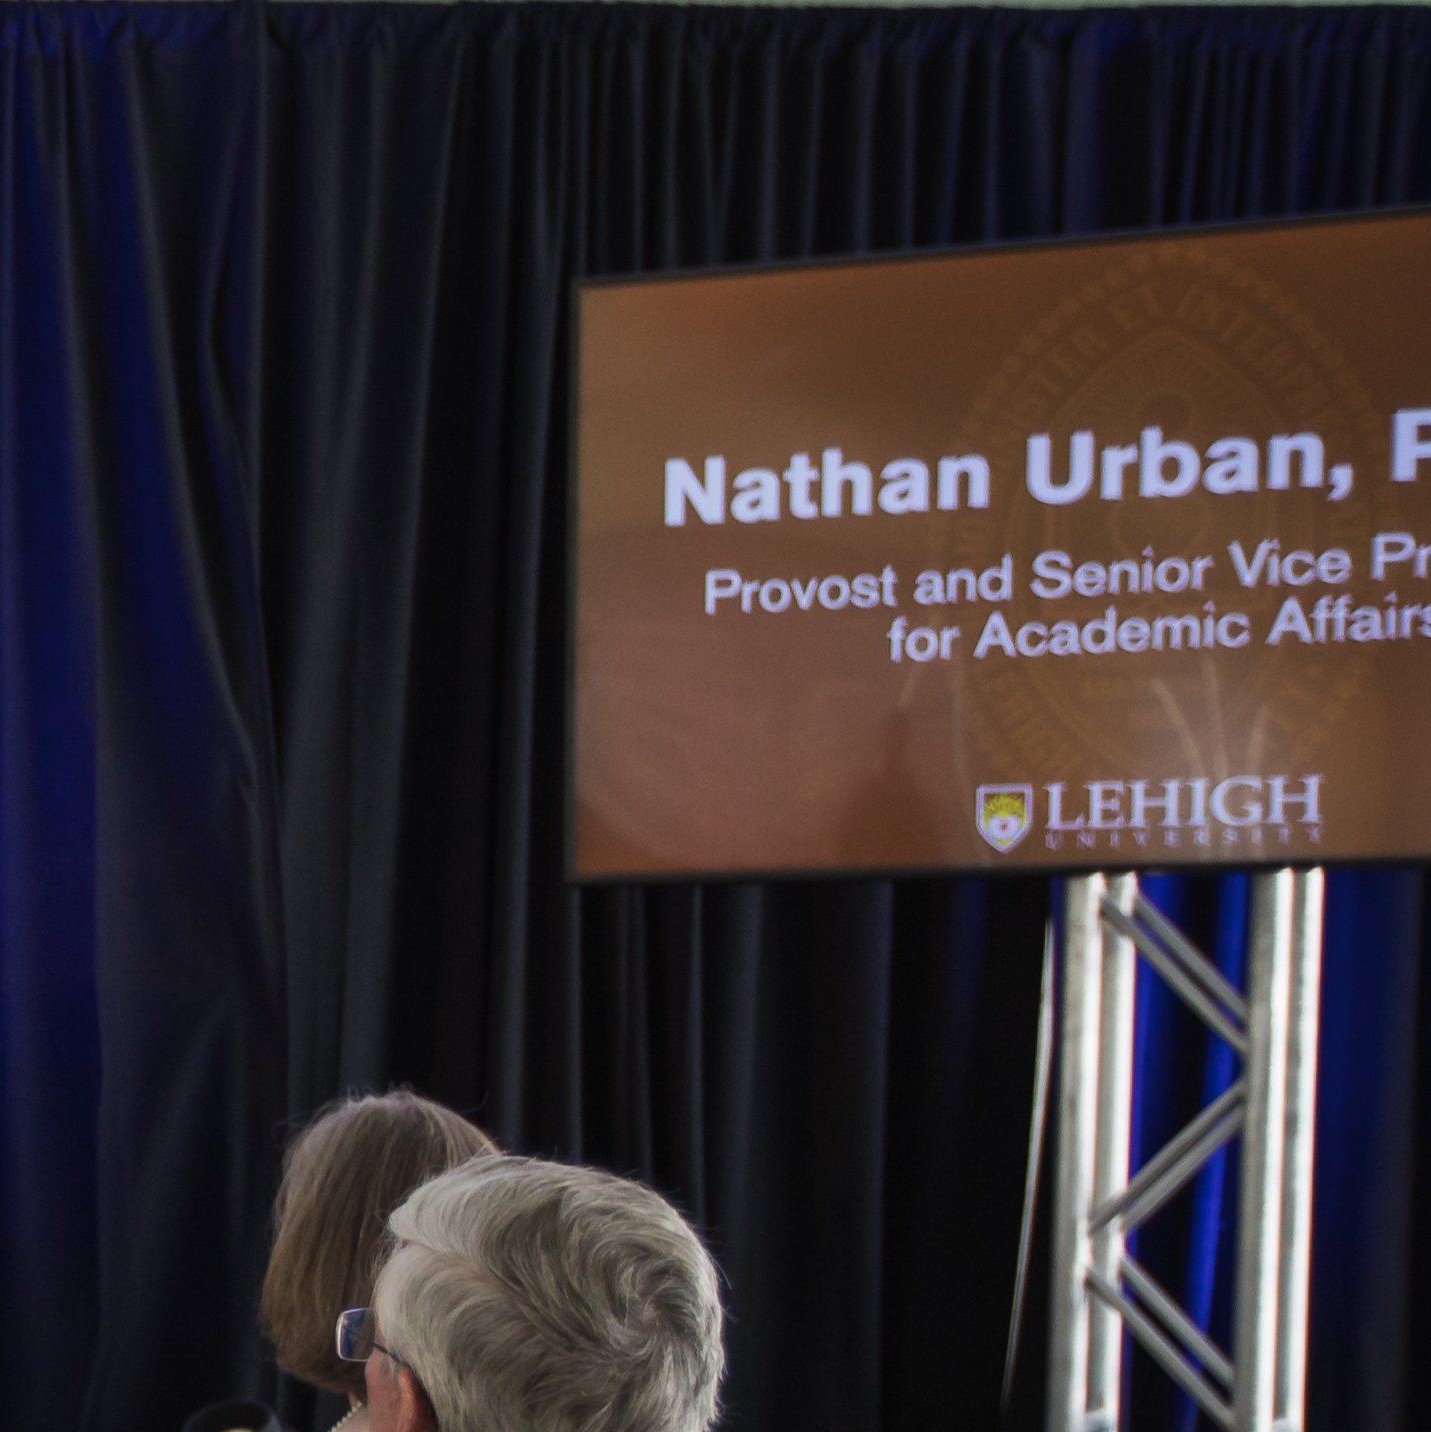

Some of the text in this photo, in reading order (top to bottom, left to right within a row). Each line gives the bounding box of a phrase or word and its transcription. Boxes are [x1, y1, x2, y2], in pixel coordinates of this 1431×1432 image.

[664, 449, 991, 526] Nathan
[1026, 427, 1353, 505] Urban,
[704, 565, 898, 615] Provost
[914, 555, 1014, 605] and
[1030, 547, 1213, 599] Senior
[1228, 540, 1352, 587] Vice
[888, 593, 1431, 662] for Academic Affairs
[1043, 774, 1325, 831] LEHIGH
[1044, 825, 1322, 851] UNIVERSITY
